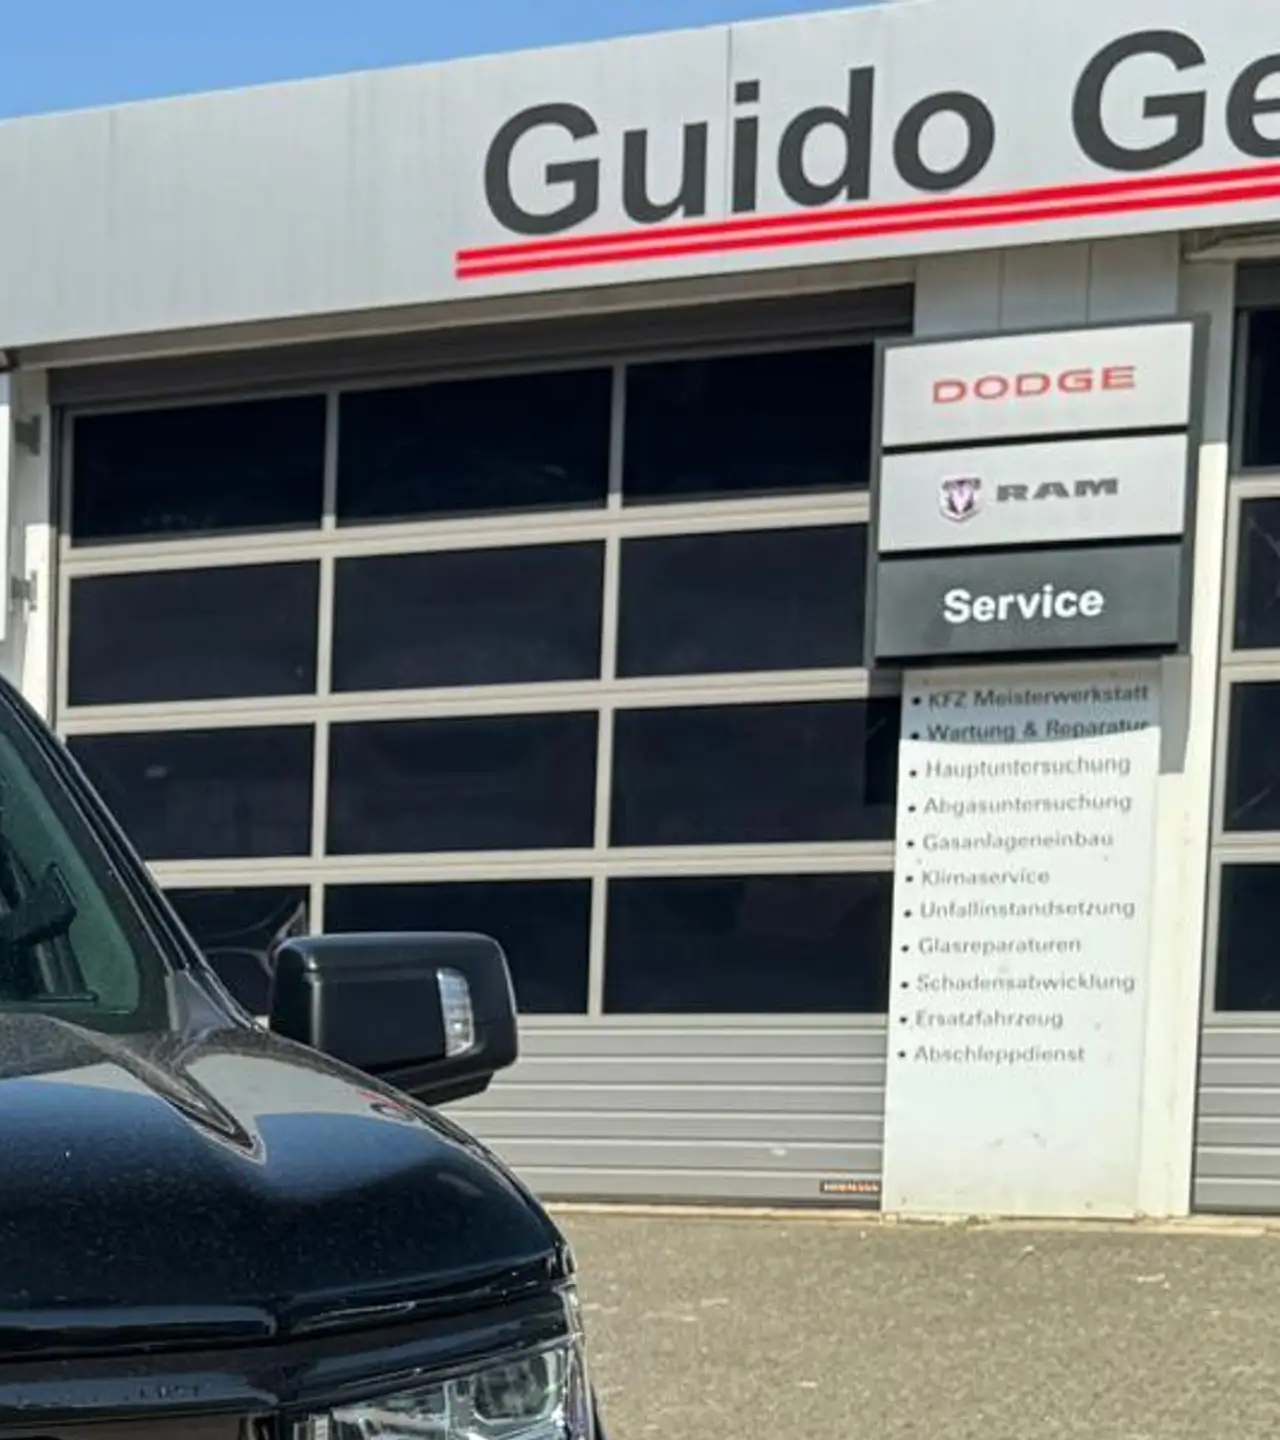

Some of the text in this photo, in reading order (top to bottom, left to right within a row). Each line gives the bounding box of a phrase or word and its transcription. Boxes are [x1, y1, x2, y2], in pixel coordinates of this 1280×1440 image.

[483, 65, 996, 237] Guido
[932, 365, 1138, 405] DODGE
[995, 477, 1120, 503] RAM
[942, 583, 1105, 624] Service
[927, 685, 1149, 710] KFZ Meisterwerkstatt
[926, 722, 1016, 742] Wartung
[1022, 720, 1038, 738] &
[925, 756, 1132, 780] Hauptuntersuchung
[923, 794, 1134, 816] Abgasuntersuchung
[922, 831, 1114, 853] Gasanlageneinbau
[921, 868, 1050, 887] Klimaservice
[919, 900, 1136, 919] Unfallinstandsetzung
[917, 937, 1082, 956] Glasreparaturen
[915, 972, 1136, 994] Schadensabwicklung
[914, 1009, 1064, 1030] Ersatzfahrzeug
[913, 1045, 1086, 1065] Abschleppdienst
